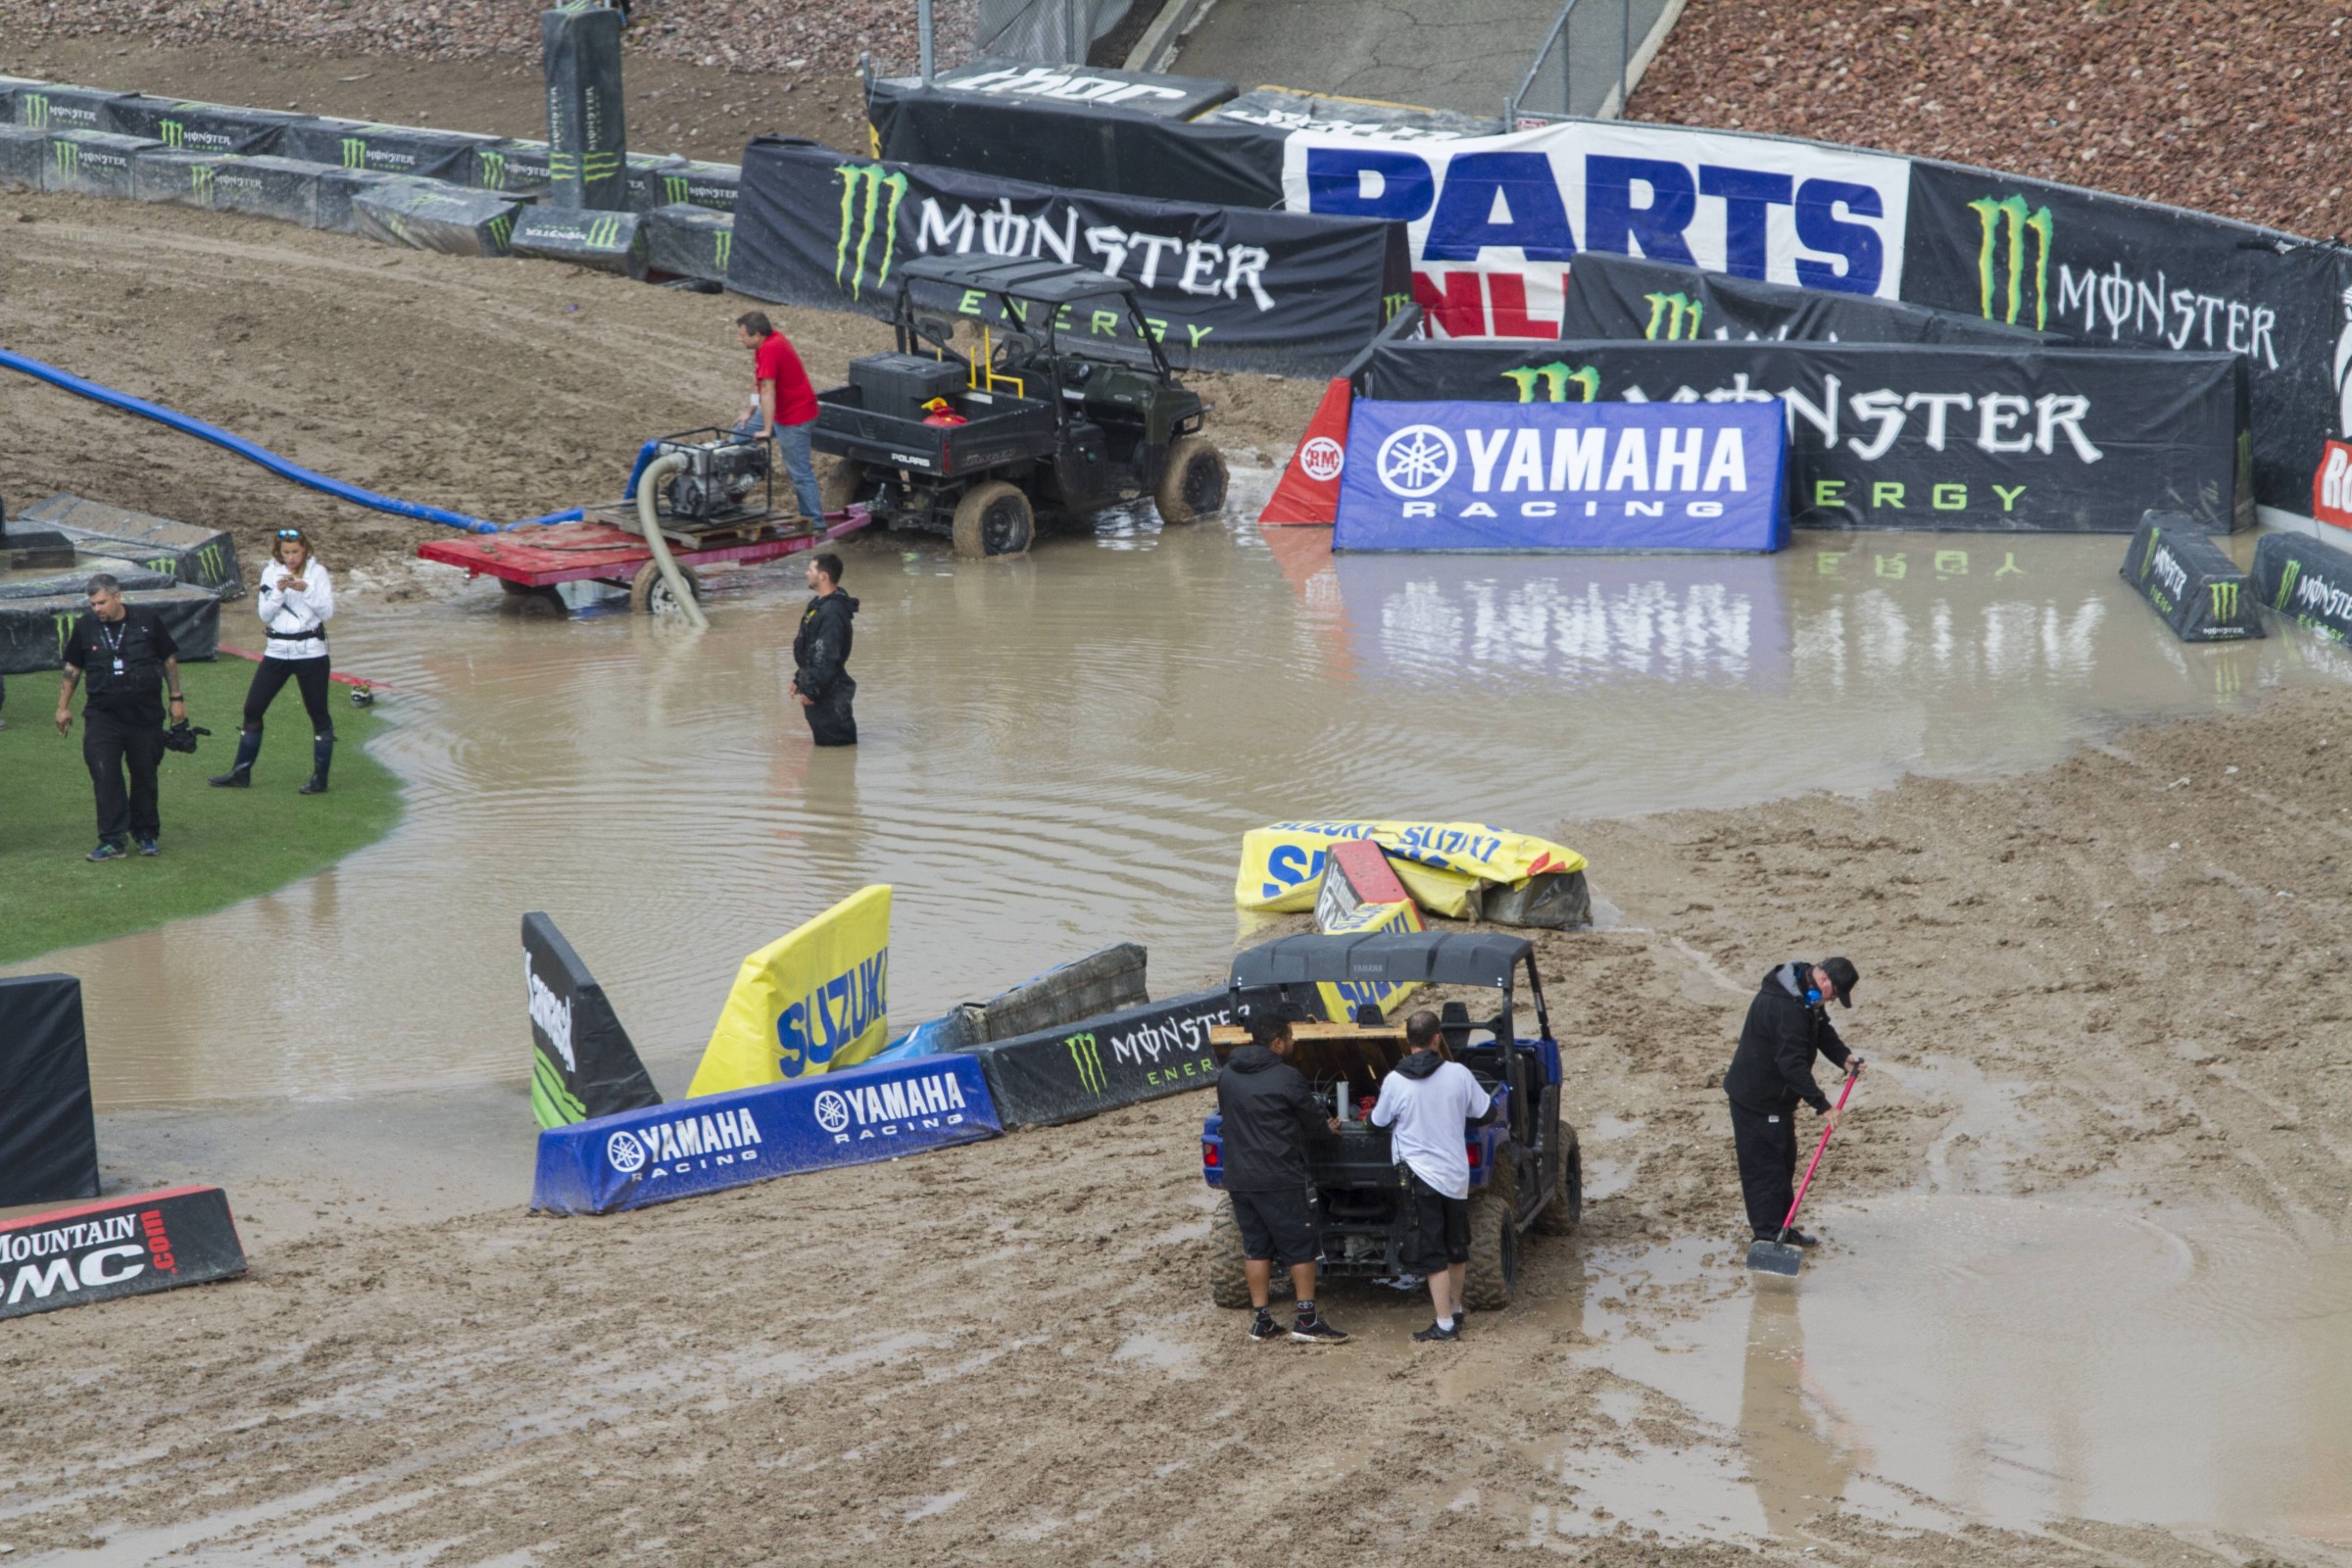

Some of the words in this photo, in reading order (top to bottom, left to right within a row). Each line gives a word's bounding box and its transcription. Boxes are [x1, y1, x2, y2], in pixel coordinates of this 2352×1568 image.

[49, 105, 96, 122] MONSTER
[183, 131, 231, 146] MONSTER
[79, 152, 126, 167] MONSTER
[1307, 147, 1884, 296] PARTS
[916, 197, 1275, 313] MONSTER
[2058, 263, 2279, 370] MONSTER
[1622, 372, 2104, 465] NSTER
[891, 452, 931, 467] POLARIS
[1466, 426, 1748, 492] YAMAHA
[1401, 501, 1725, 518] RACING
[1816, 480, 2028, 512] ERGY
[2297, 574, 2352, 620] MONSTE
[1147, 1057, 1214, 1086] ENER
[845, 1072, 966, 1125] YAMAHA
[638, 1107, 762, 1163] YAMAHA
[834, 1113, 963, 1144] RACING
[631, 1150, 758, 1182] RACING
[140, 1209, 178, 1274] .com
